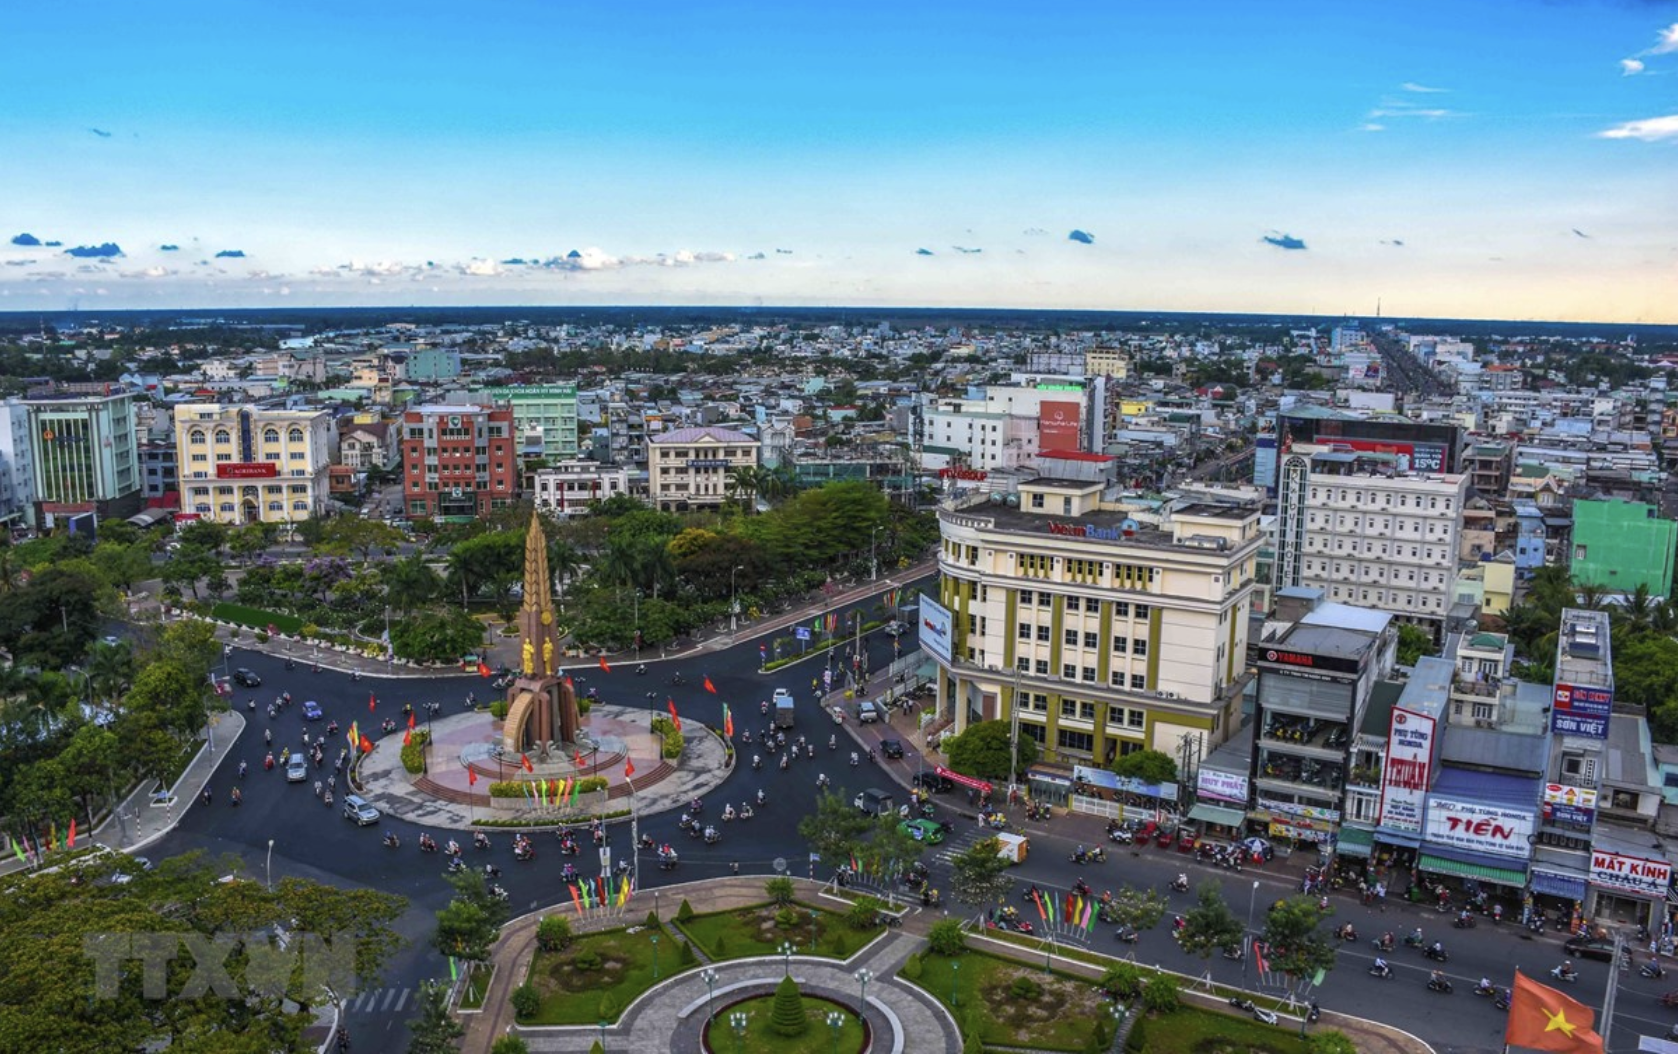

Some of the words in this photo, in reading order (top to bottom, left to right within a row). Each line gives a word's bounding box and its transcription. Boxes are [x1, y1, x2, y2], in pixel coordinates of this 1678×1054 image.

[1278, 652, 1313, 666] YAMAHA
[1556, 719, 1577, 730] SƠN
[1580, 722, 1604, 735] VIỆT
[1629, 861, 1668, 880] KÍNH
